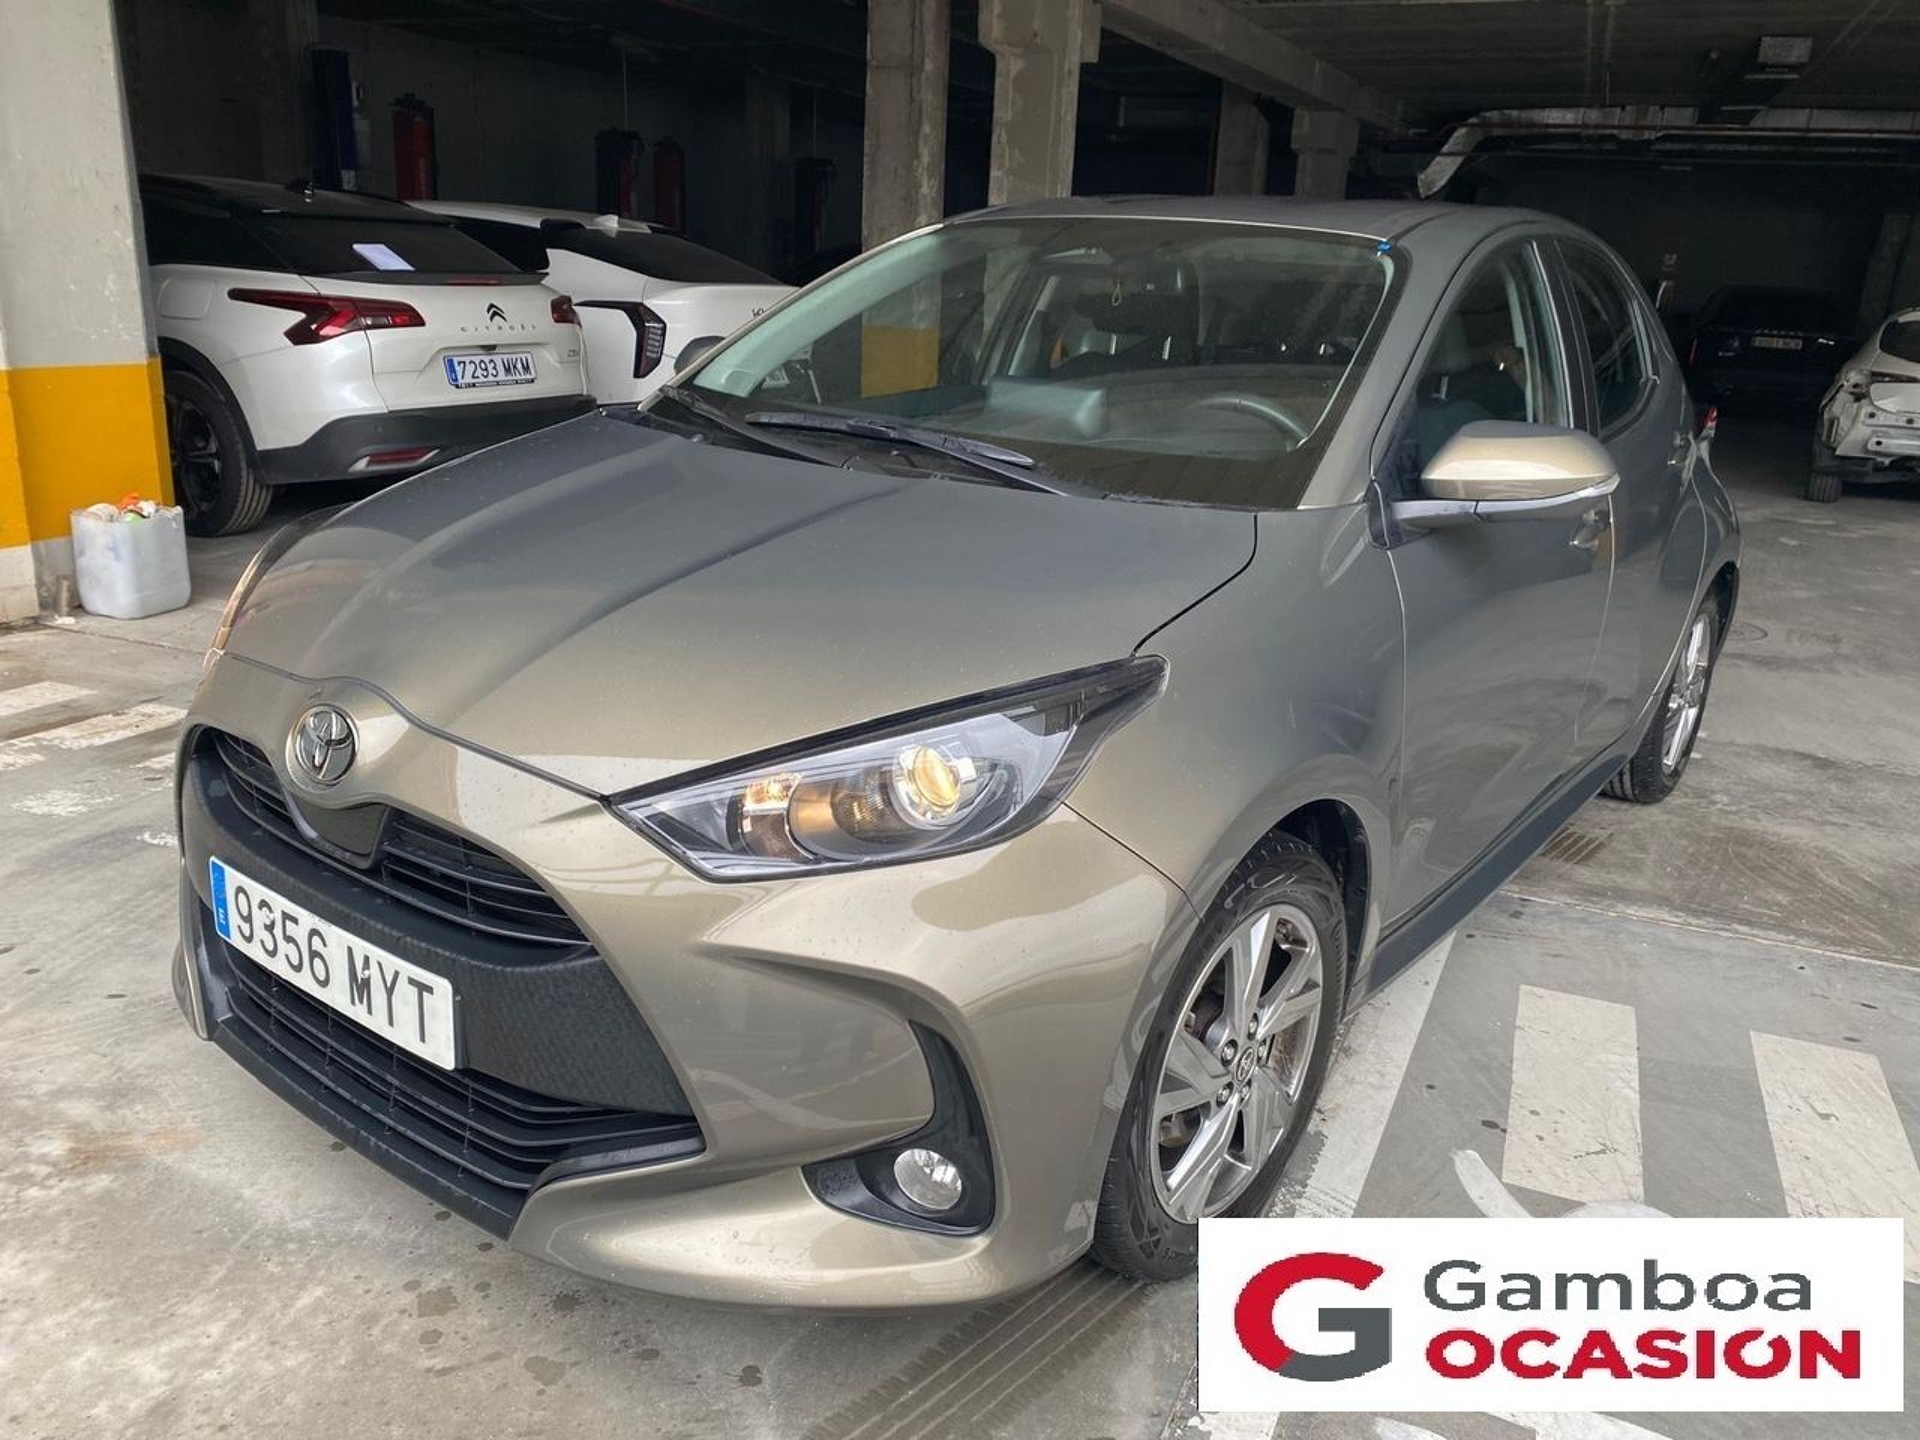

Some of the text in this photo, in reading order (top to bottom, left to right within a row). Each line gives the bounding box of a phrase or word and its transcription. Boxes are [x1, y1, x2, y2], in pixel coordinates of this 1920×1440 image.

[457, 356, 532, 380] 7293 MKM
[234, 885, 435, 1045] 9356 MYT
